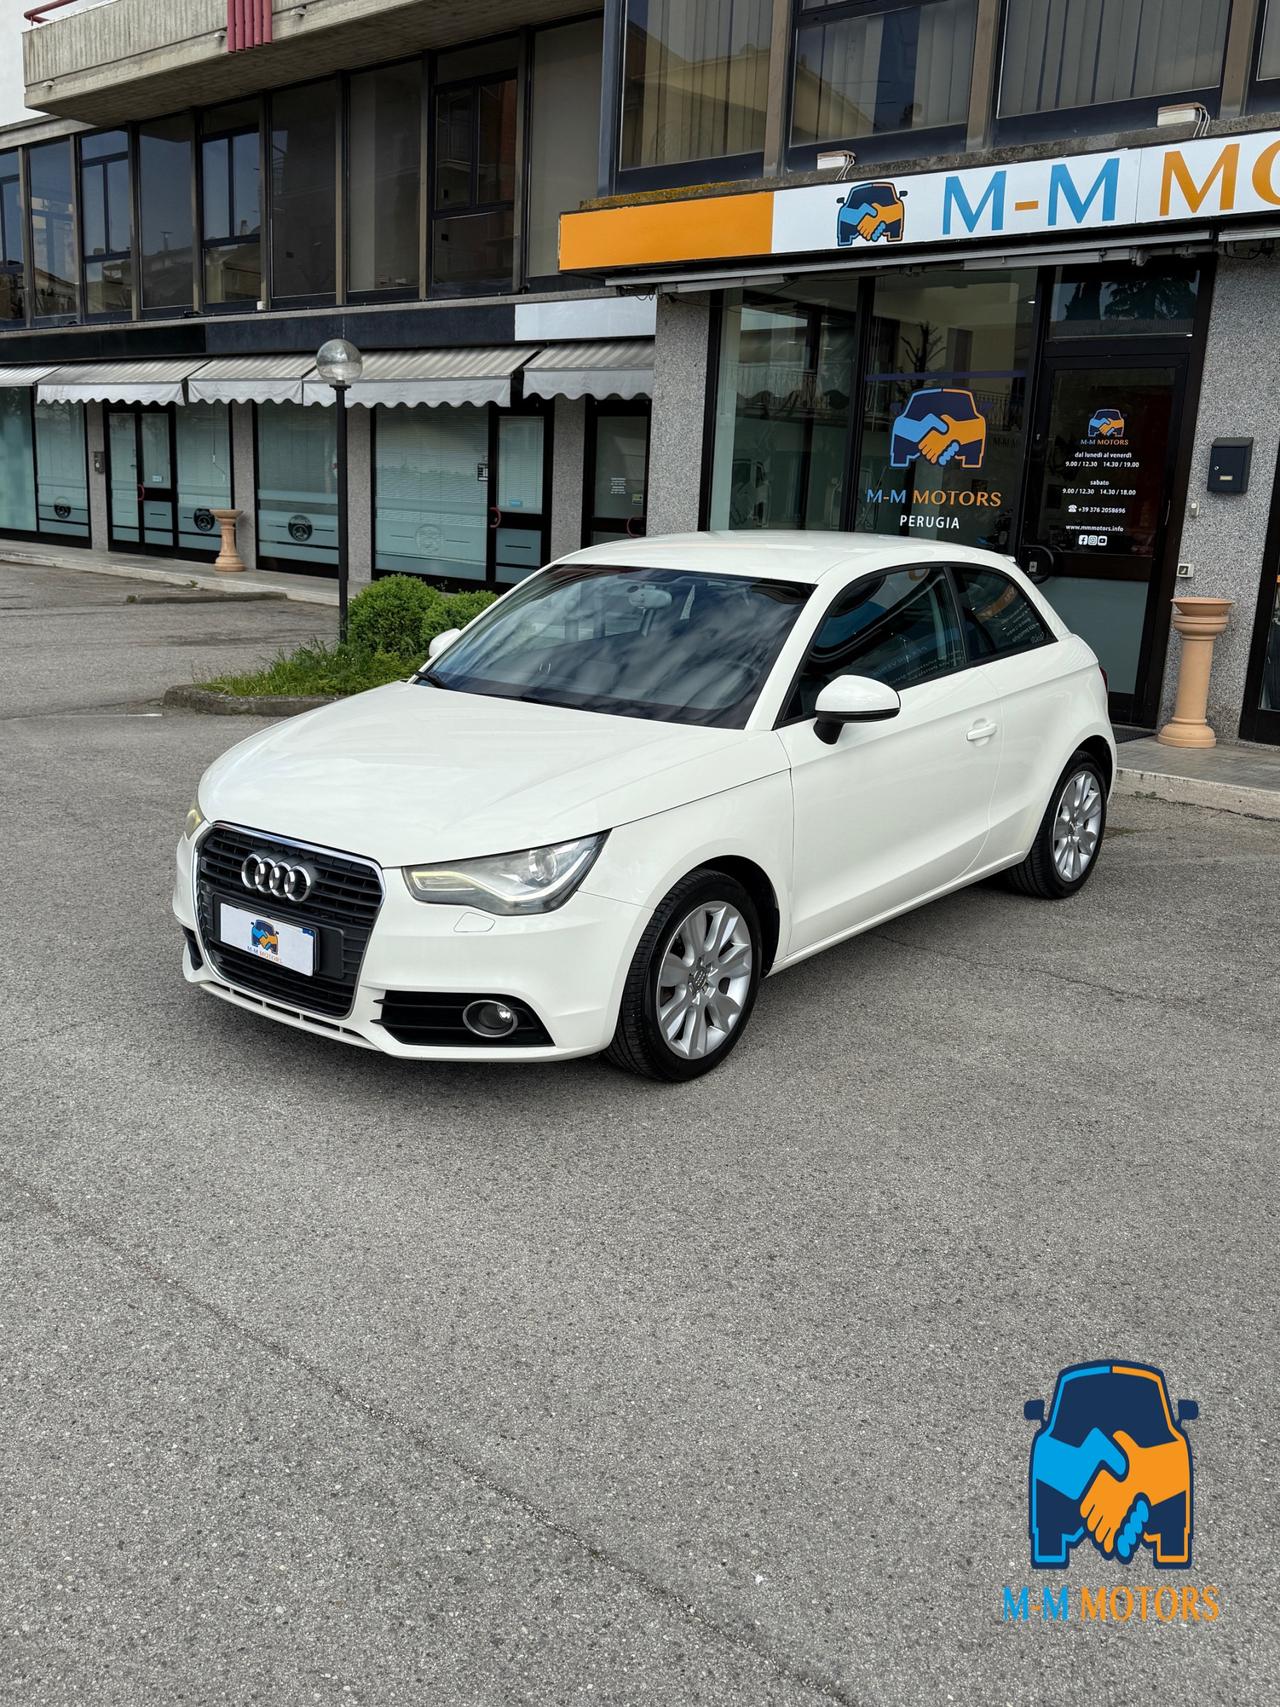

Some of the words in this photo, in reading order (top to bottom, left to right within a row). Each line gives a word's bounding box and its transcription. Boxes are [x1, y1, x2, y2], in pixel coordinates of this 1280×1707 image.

[942, 157, 1120, 235] M-M
[866, 489, 906, 503] M-M
[913, 490, 1002, 507] MOTORS
[899, 515, 960, 529] PERUGIA
